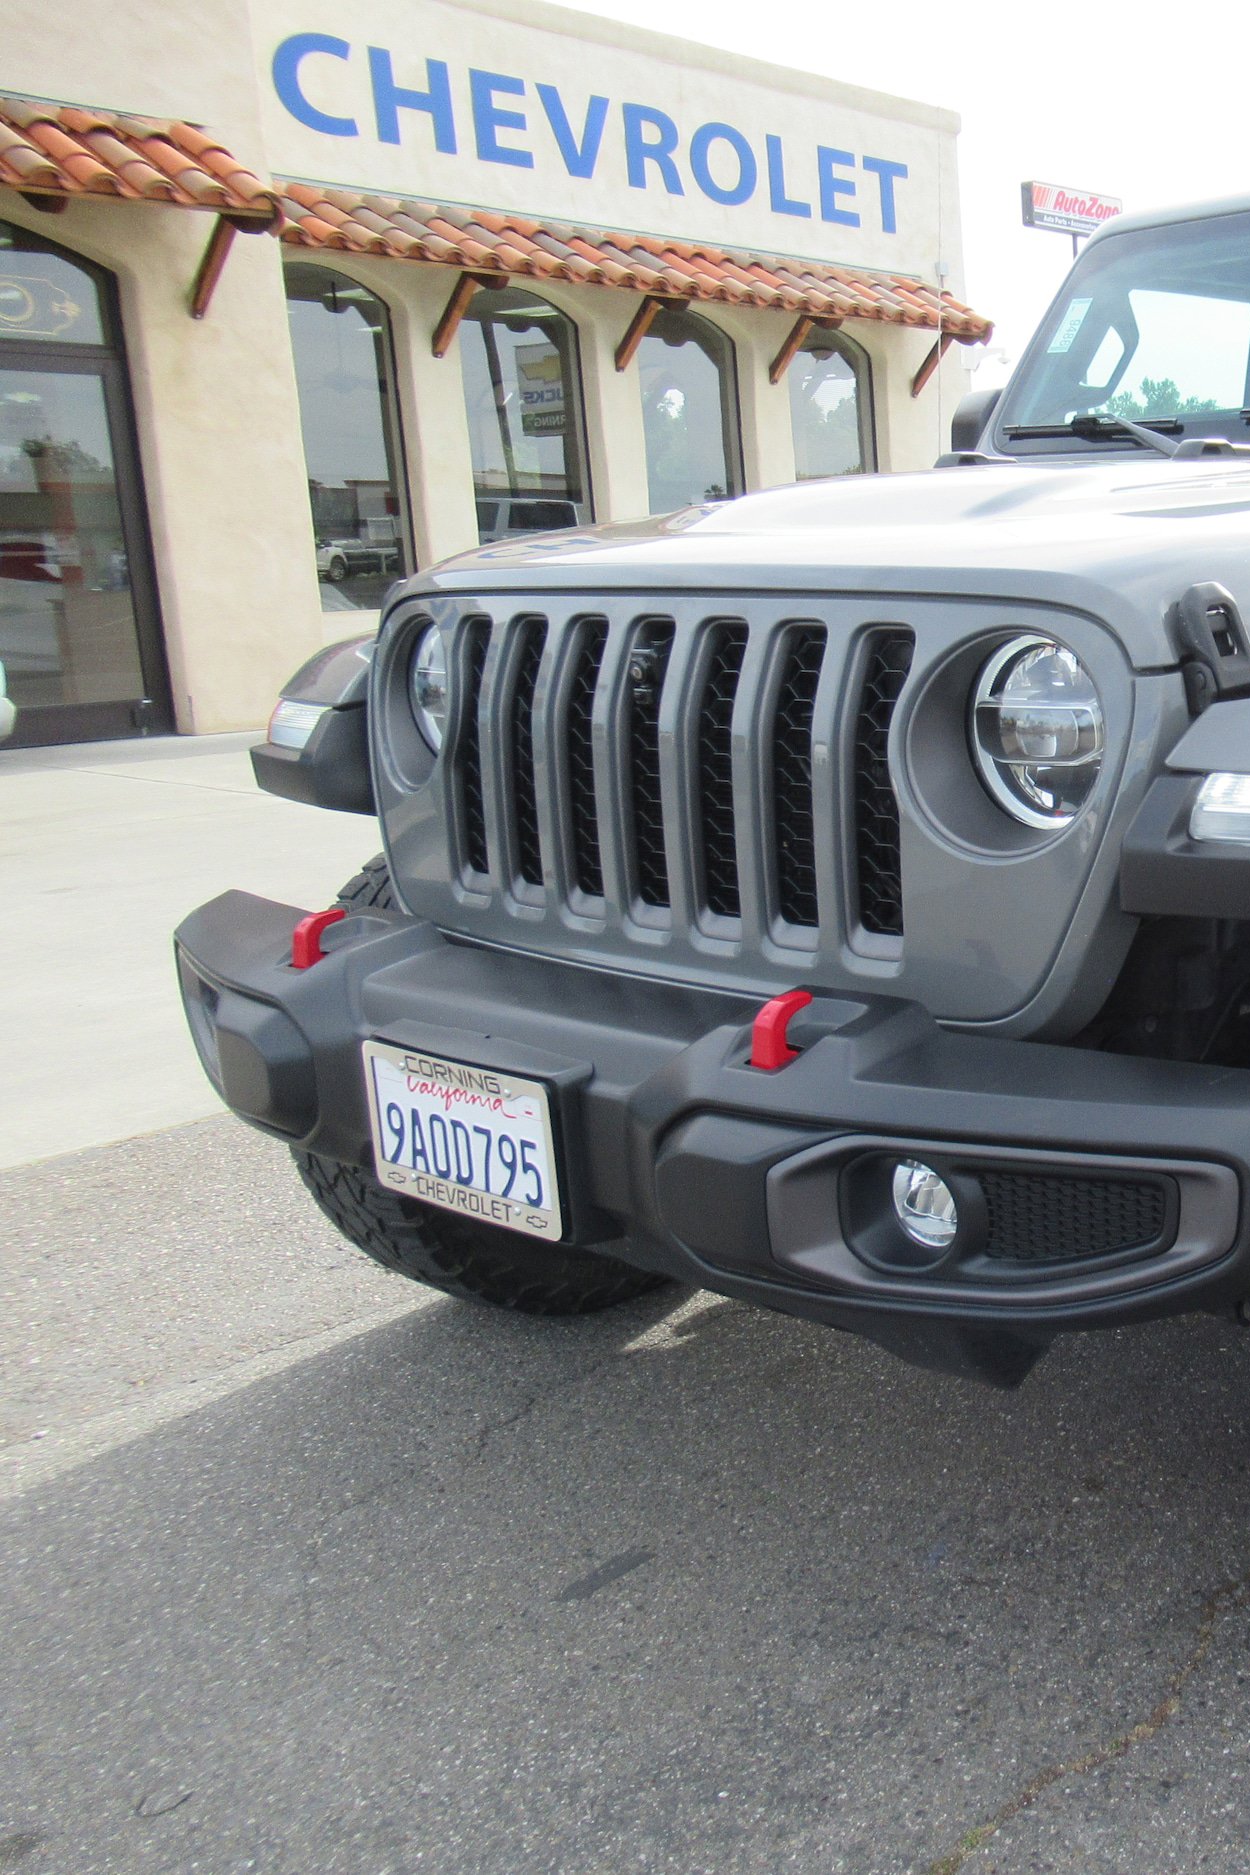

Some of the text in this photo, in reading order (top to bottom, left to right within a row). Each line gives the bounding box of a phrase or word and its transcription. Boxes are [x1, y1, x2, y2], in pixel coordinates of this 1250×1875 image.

[271, 32, 908, 234] CHEVROLET
[404, 1055, 501, 1094] CORNING
[416, 1176, 513, 1222] CHEVROLET
